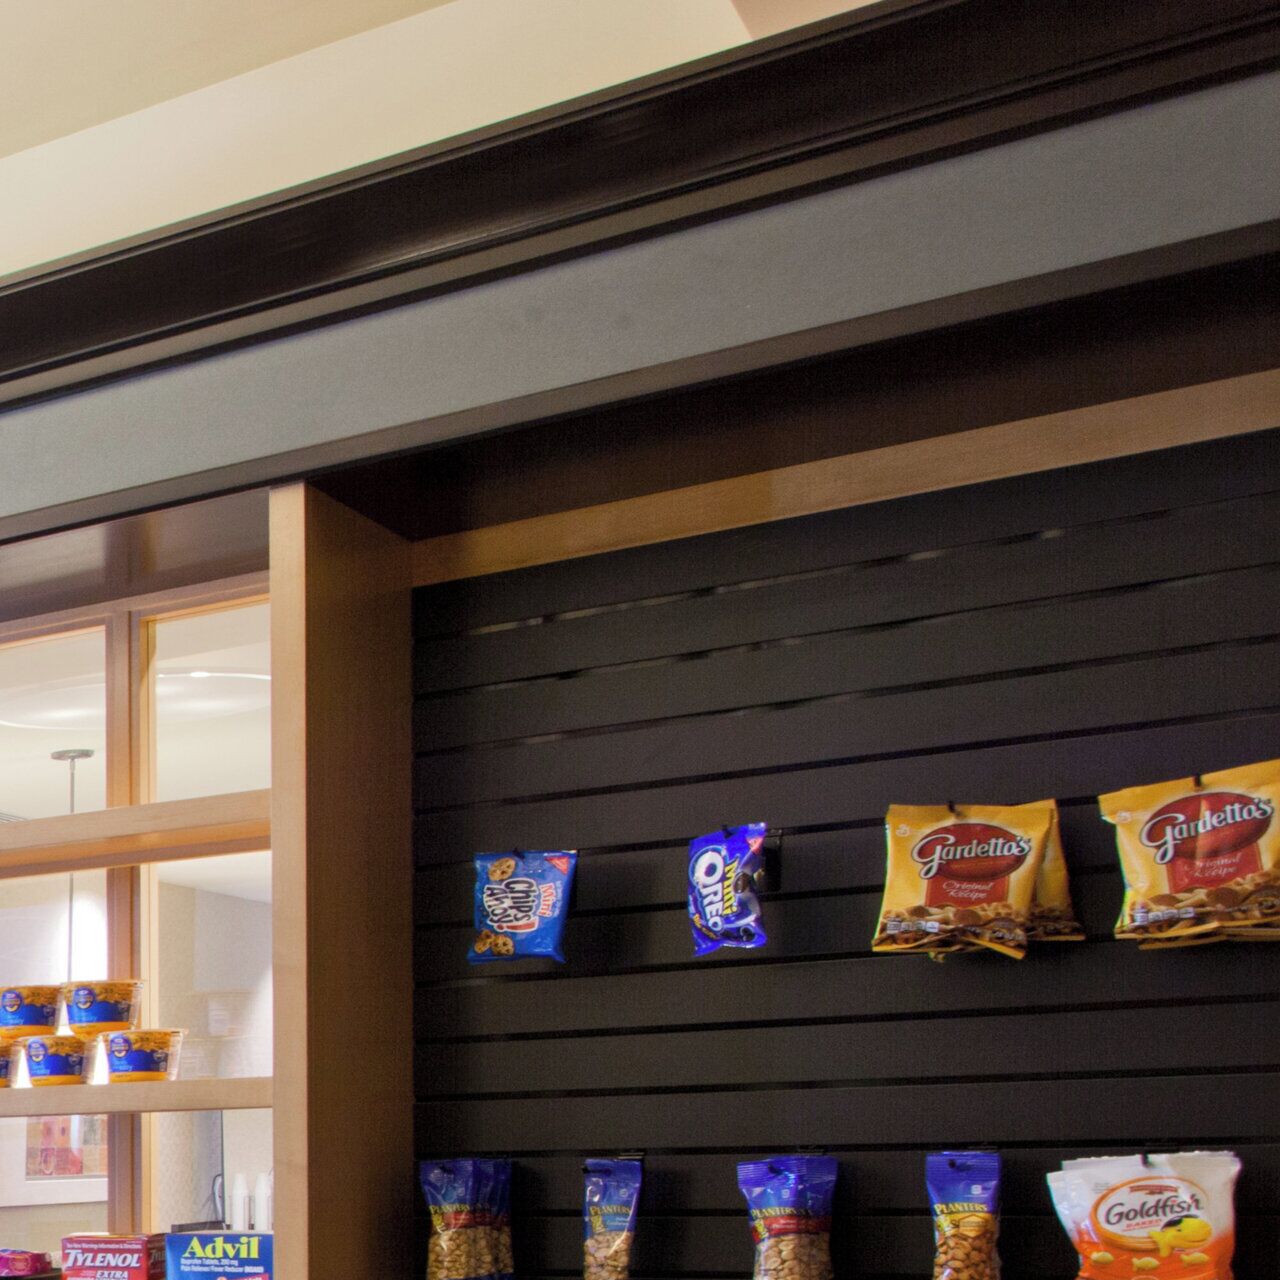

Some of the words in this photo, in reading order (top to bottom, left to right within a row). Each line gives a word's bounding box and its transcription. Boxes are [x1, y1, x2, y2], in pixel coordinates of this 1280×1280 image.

[1141, 798, 1274, 865] Gardetto's
[911, 833, 1032, 880] Gardetto's
[693, 849, 725, 932] OREO
[933, 1202, 989, 1214] PLANTERS
[1105, 1194, 1202, 1226] Goldfish
[64, 1249, 141, 1268] TYLENOL
[182, 1236, 259, 1259] Advil
[96, 1270, 129, 1279] EXTRA
